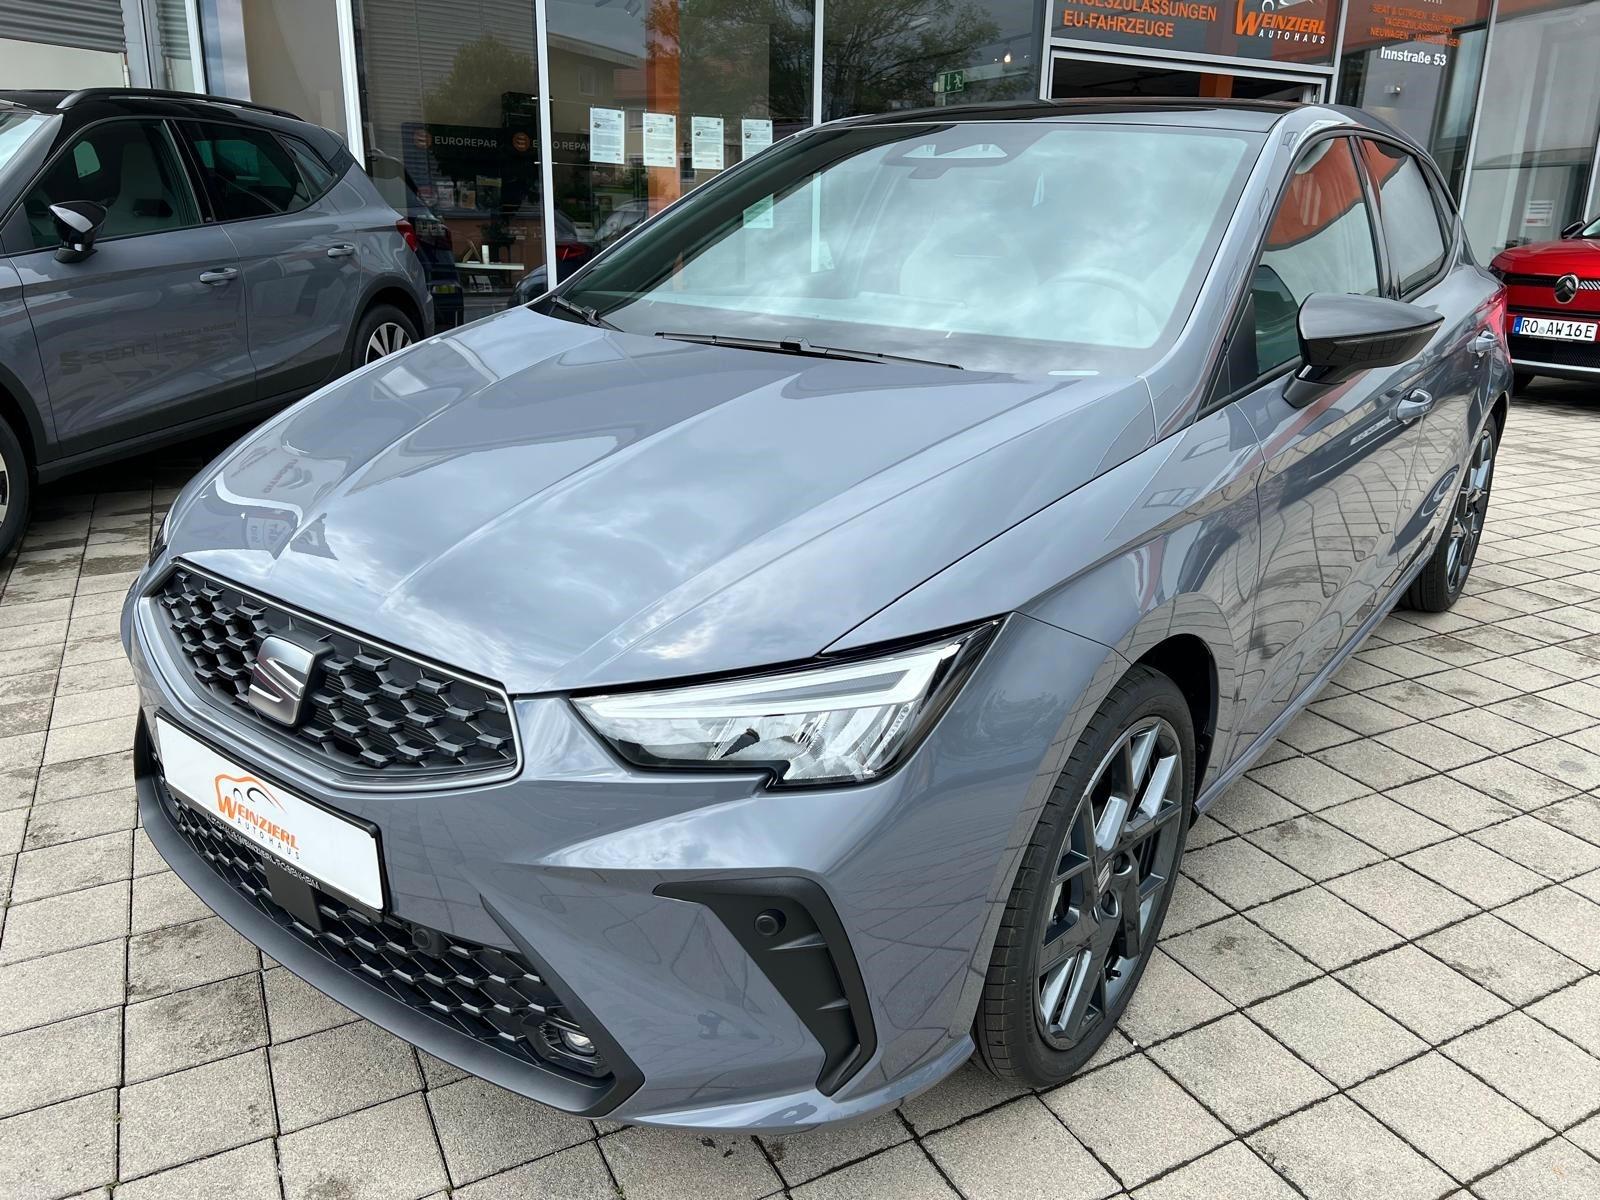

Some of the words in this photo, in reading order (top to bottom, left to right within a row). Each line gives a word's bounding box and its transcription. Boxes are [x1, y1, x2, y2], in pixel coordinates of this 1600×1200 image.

[1068, 0, 1216, 21] SZULASSUNGEN
[1063, 10, 1175, 38] EU-FAHRZEUGE
[1235, 9, 1327, 36] WEINZIERL
[1258, 28, 1326, 44] AUTOHAUS
[1380, 46, 1431, 65] Innstraße
[1433, 53, 1447, 66] 53
[434, 135, 498, 149] EUROREPAR
[1521, 319, 1539, 334] RO
[217, 795, 300, 851] WEINZIERL
[237, 817, 300, 860] AUTOHAUS
